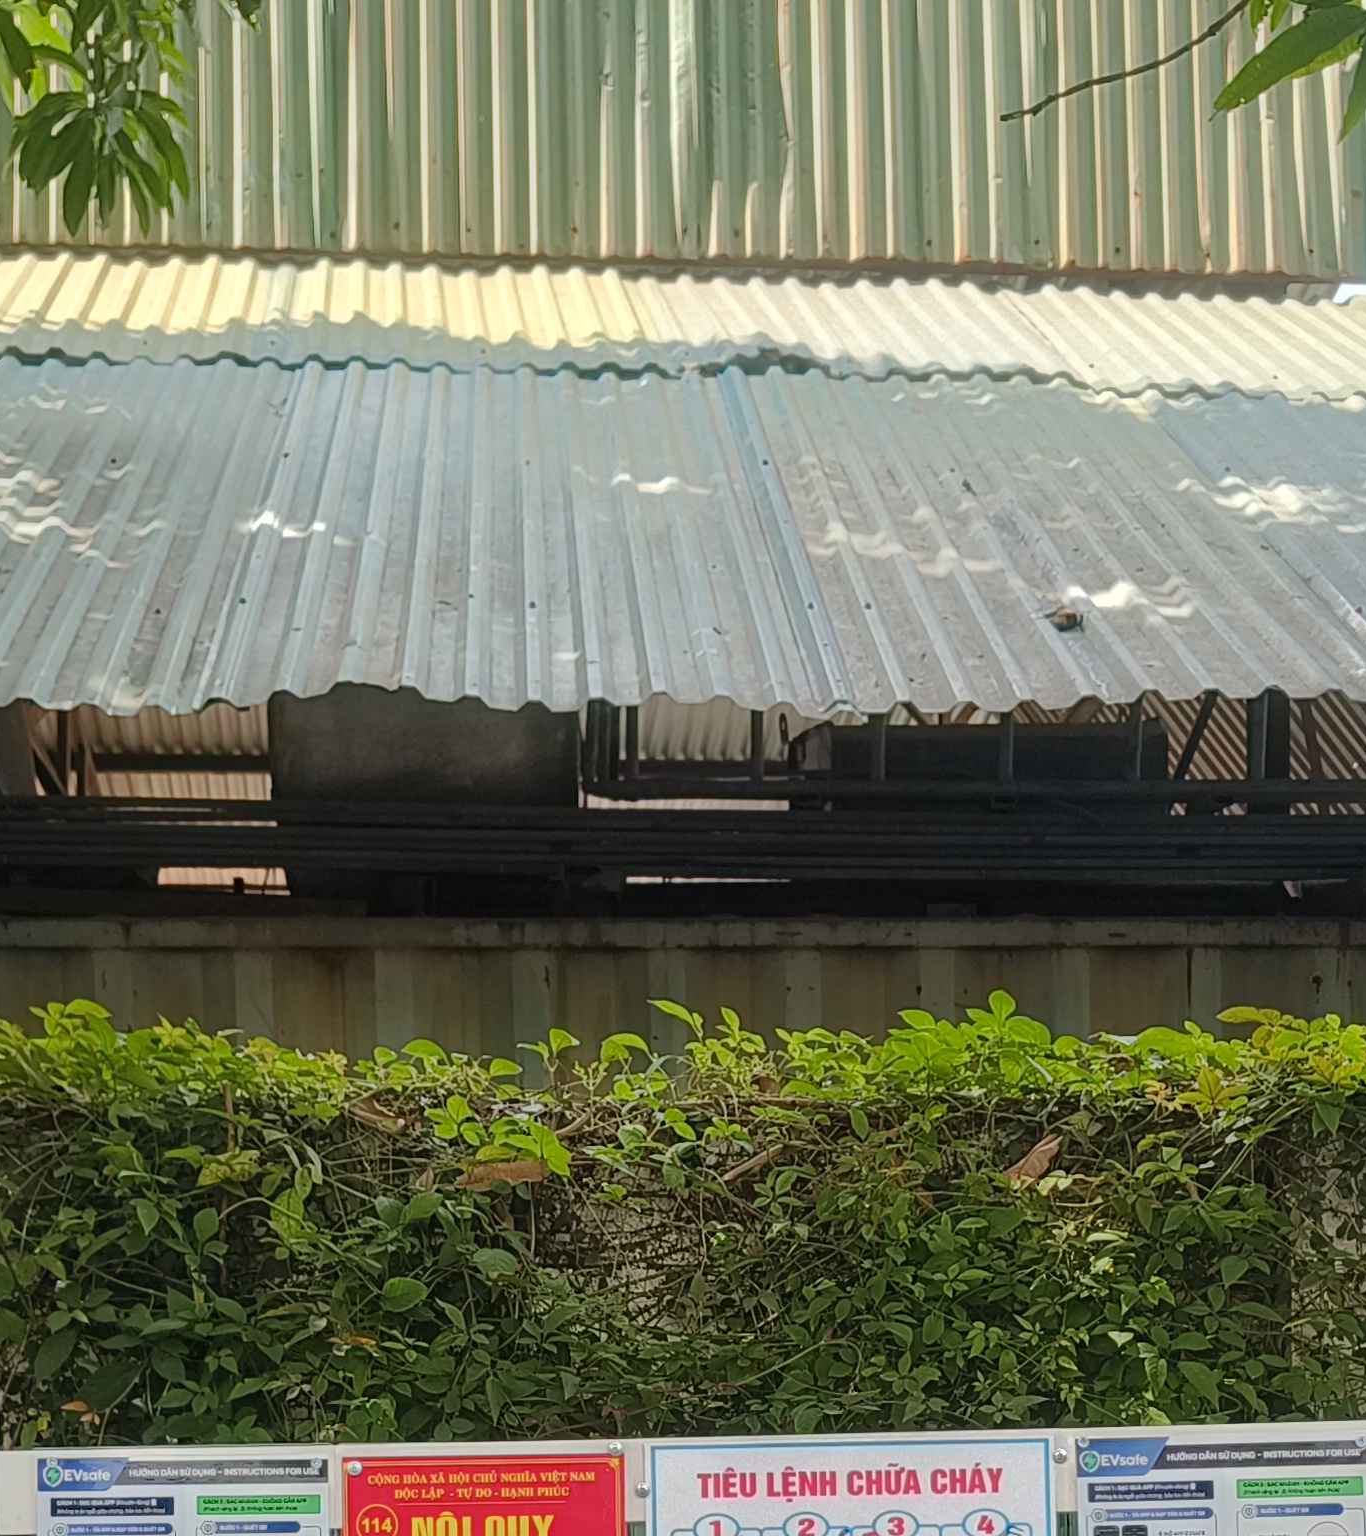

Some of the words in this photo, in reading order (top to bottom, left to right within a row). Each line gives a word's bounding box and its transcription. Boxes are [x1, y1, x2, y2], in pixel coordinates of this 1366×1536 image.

[1101, 1455, 1148, 1468] EVsafe
[1166, 1451, 1197, 1462] HƯỚNG
[1198, 1450, 1217, 1461] DẪN
[1230, 1451, 1257, 1462] DỤNG
[1263, 1449, 1324, 1460] INSTRUCTIONS
[1325, 1449, 1343, 1458] FOR
[1344, 1448, 1362, 1458] USE
[63, 1468, 111, 1482] EVsafe
[223, 1466, 284, 1477] INSTRUCTIONS
[285, 1467, 303, 1476] FOR
[368, 1473, 399, 1487] CỘNG
[403, 1472, 427, 1484] HÒA
[430, 1472, 445, 1484] XÃ
[449, 1472, 469, 1485] HỘI
[473, 1470, 497, 1483] CHỦ
[500, 1471, 537, 1483] NGHĨA
[539, 1471, 567, 1484] VIỆT
[570, 1472, 595, 1482] NAM
[697, 1467, 757, 1498] TIÊU
[766, 1467, 837, 1503] LỆNH
[847, 1463, 922, 1496] CHỮA
[930, 1462, 1003, 1494] CHÁY
[395, 1487, 419, 1501] ĐỘC
[421, 1487, 445, 1500] LẬP
[456, 1486, 473, 1499] TỰ
[475, 1487, 492, 1497] DO
[501, 1487, 533, 1499] HẠNH
[537, 1485, 570, 1497] PHÚC
[361, 1517, 393, 1533] 114
[887, 1517, 905, 1536] 3
[977, 1515, 995, 1535] 4
